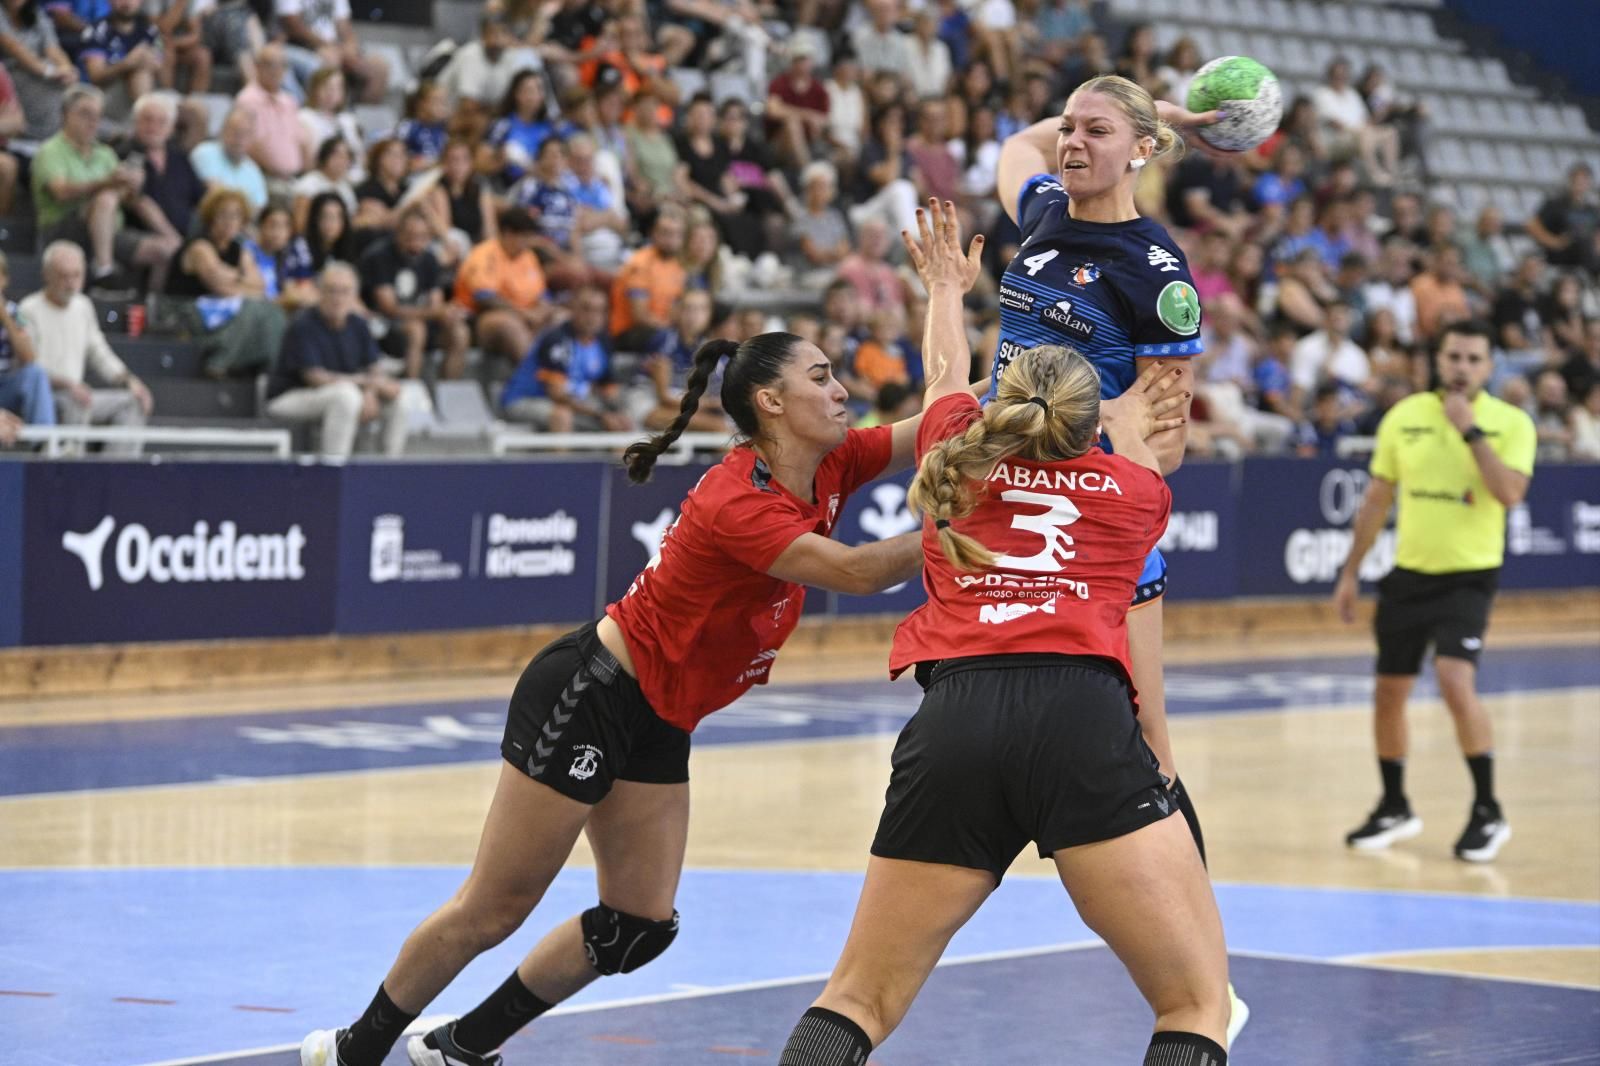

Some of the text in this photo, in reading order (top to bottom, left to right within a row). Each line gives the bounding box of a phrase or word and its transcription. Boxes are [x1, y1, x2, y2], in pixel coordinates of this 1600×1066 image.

[1023, 248, 1060, 277] 4
[990, 462, 1123, 496] ABANCA
[115, 519, 307, 584] Occident
[993, 489, 1082, 572] 3
